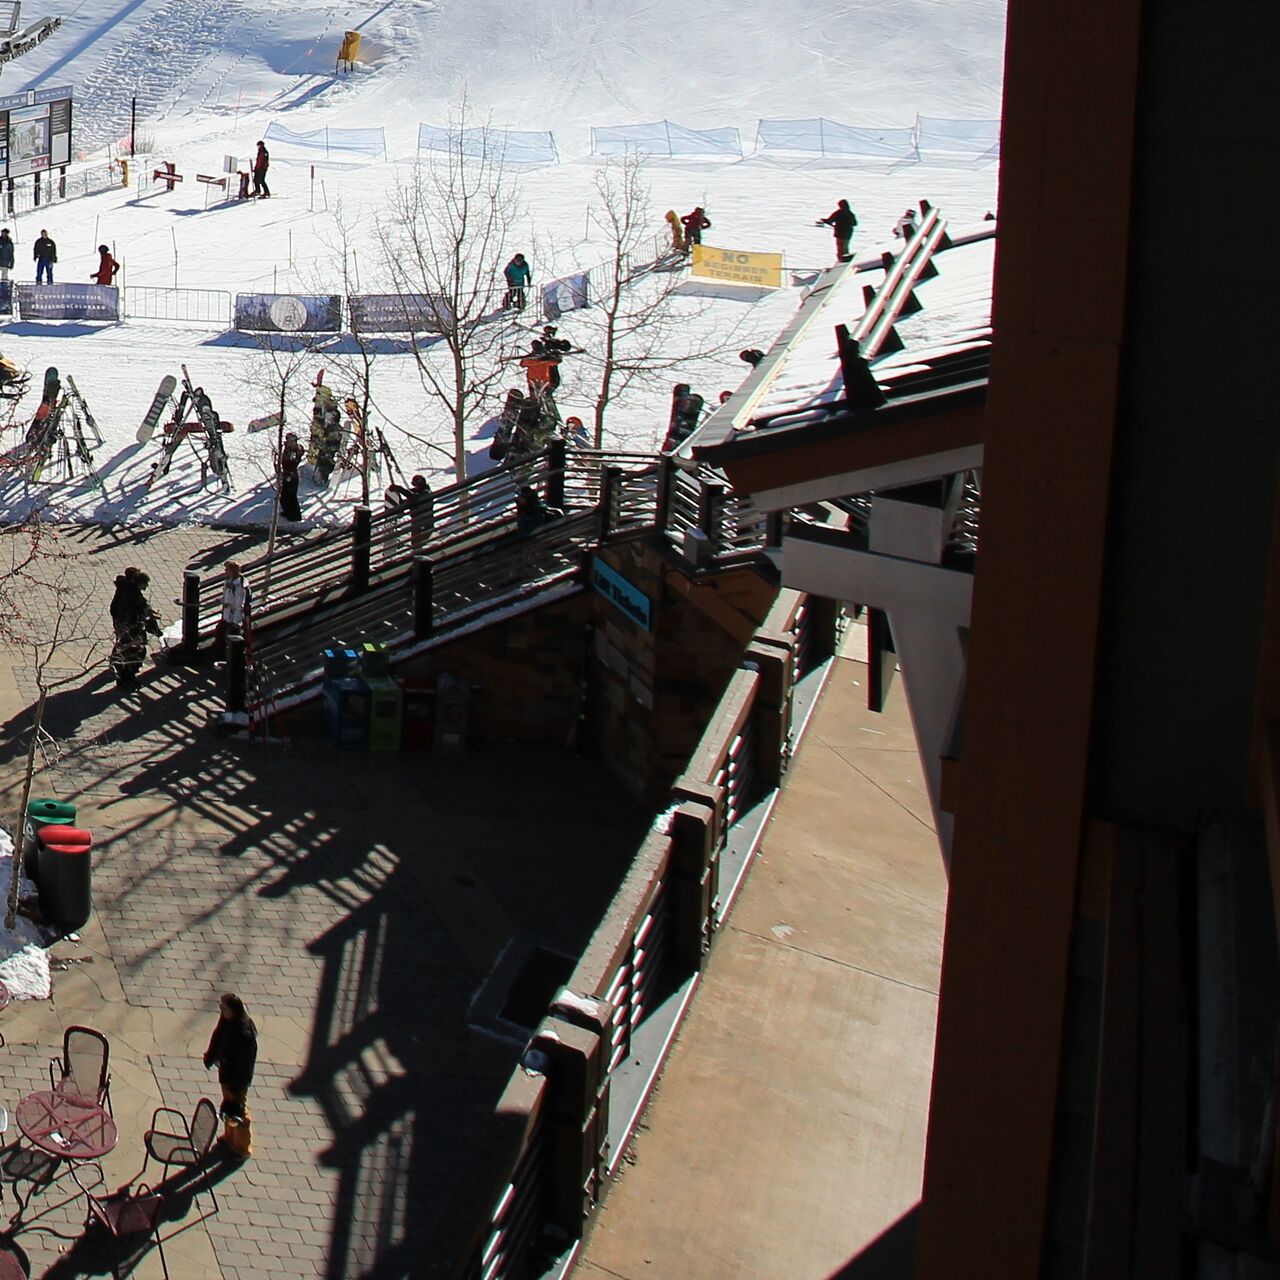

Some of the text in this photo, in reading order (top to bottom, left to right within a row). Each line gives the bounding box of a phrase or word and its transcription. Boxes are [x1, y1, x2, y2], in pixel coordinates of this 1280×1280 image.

[722, 252, 749, 264] NO
[703, 261, 768, 275] BEGINNER
[710, 269, 762, 283] TERRAIN
